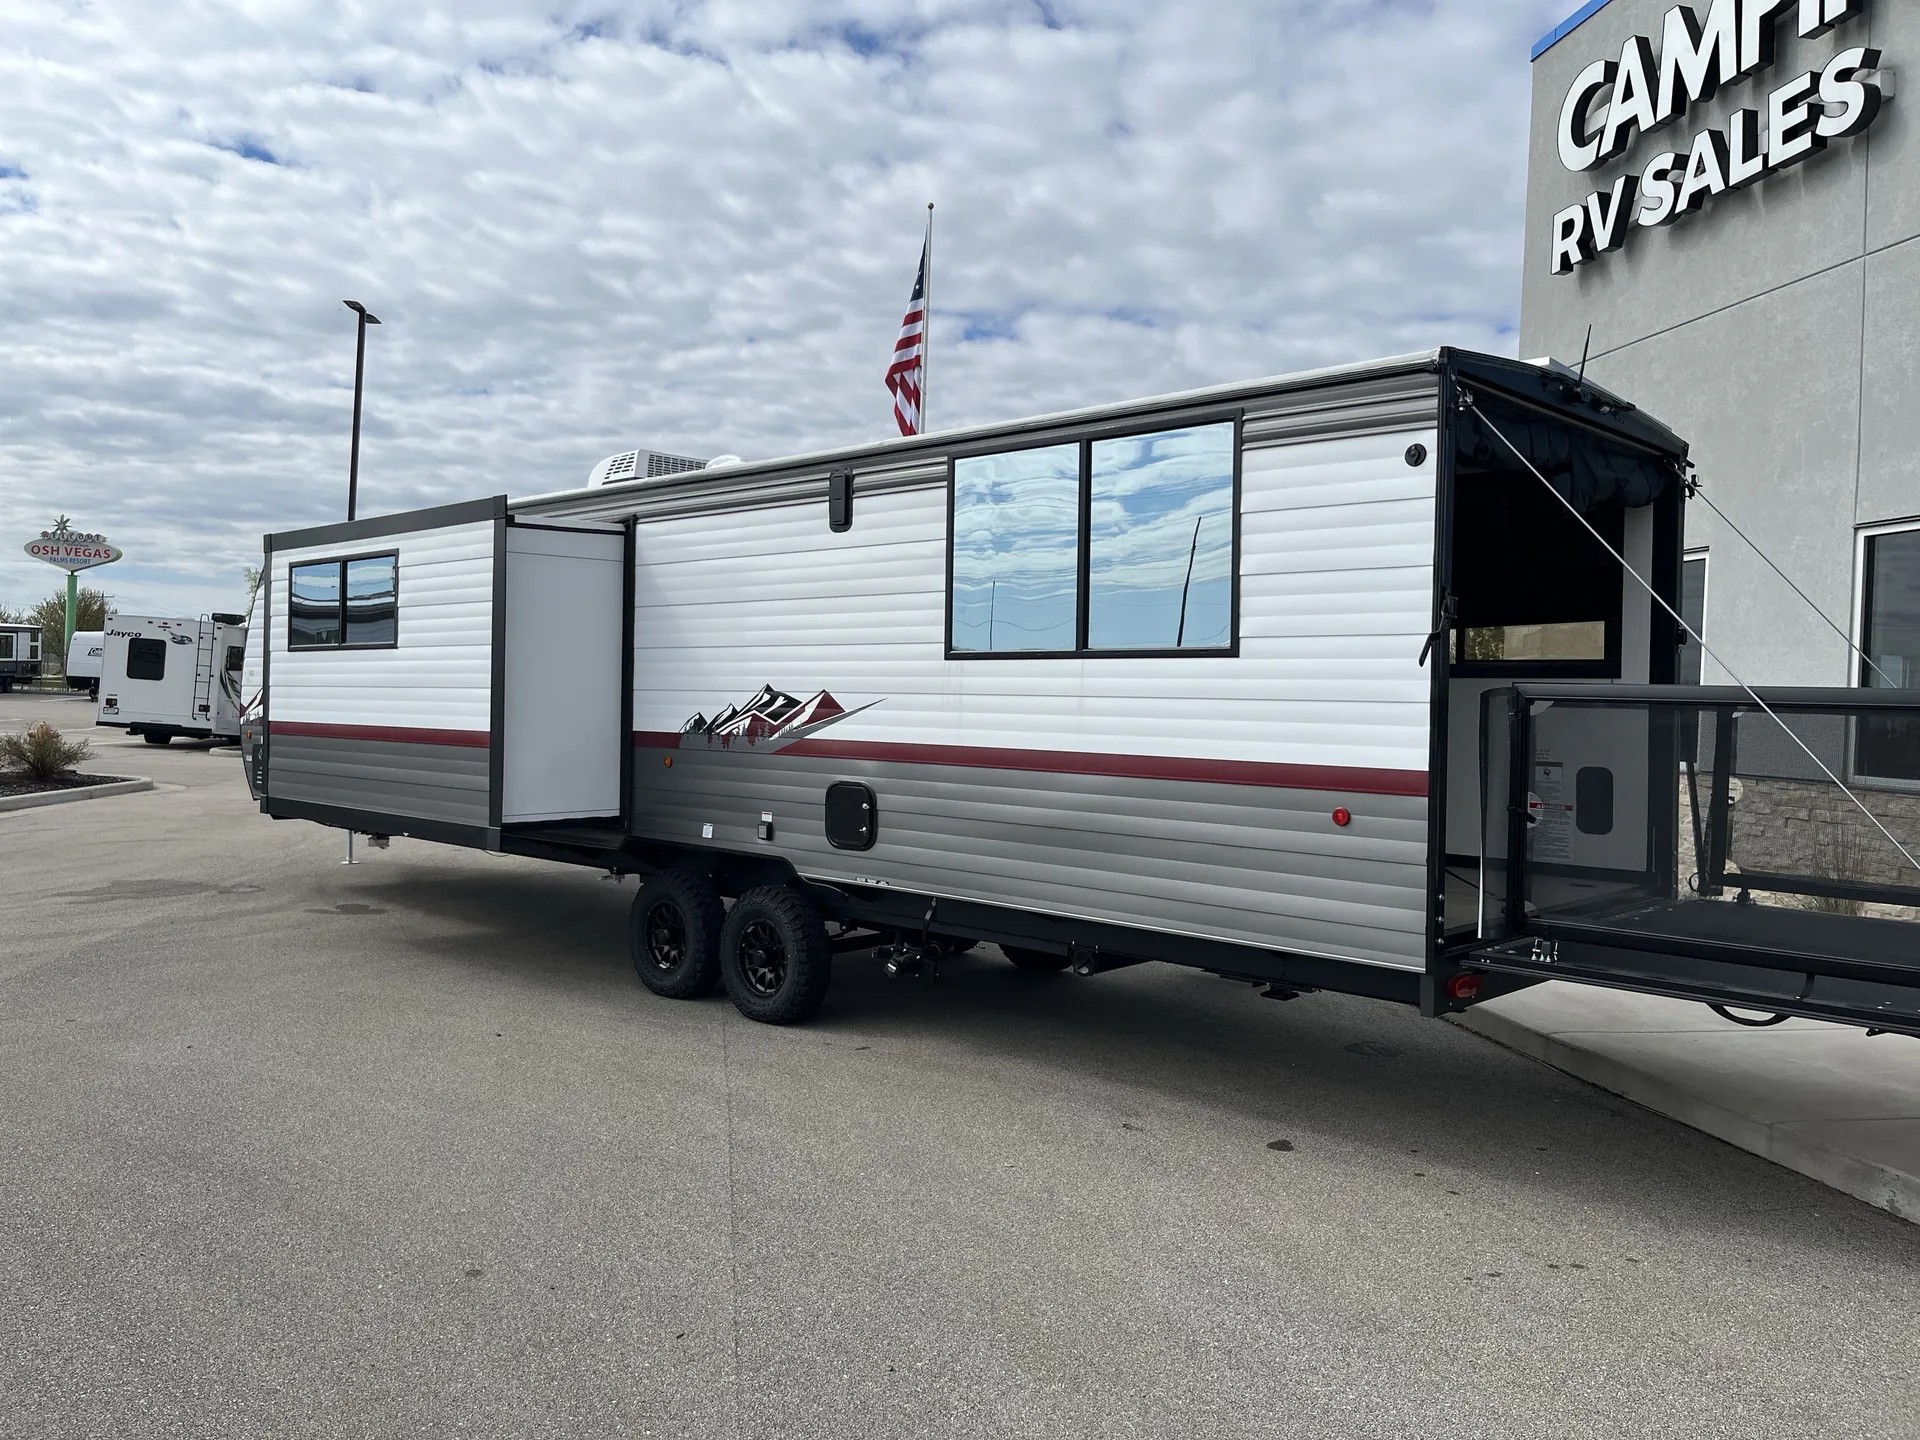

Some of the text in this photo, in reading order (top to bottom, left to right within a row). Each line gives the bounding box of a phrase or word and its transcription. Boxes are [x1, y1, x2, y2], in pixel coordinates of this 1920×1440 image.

[1551, 47, 1876, 275] RV SALES
[41, 531, 102, 542] WELCOME
[31, 545, 111, 559] OSH VEGAS
[49, 556, 69, 564] PALMS
[106, 629, 142, 638] Jayco
